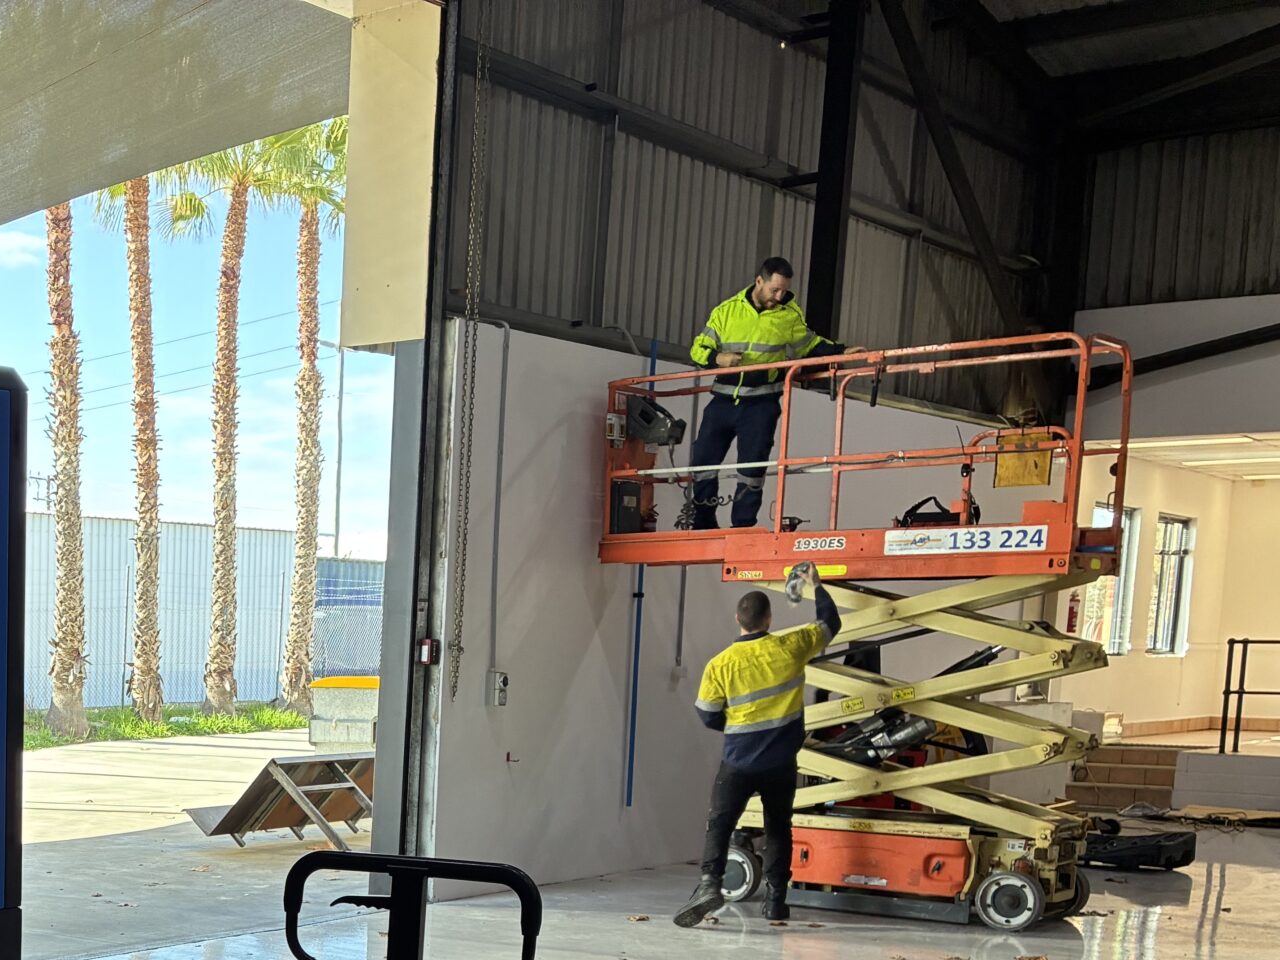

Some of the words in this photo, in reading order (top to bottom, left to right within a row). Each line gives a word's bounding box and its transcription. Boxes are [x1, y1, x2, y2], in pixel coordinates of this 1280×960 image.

[795, 538, 845, 549] 1930ES
[948, 530, 991, 550] 133
[999, 528, 1044, 548] 224
